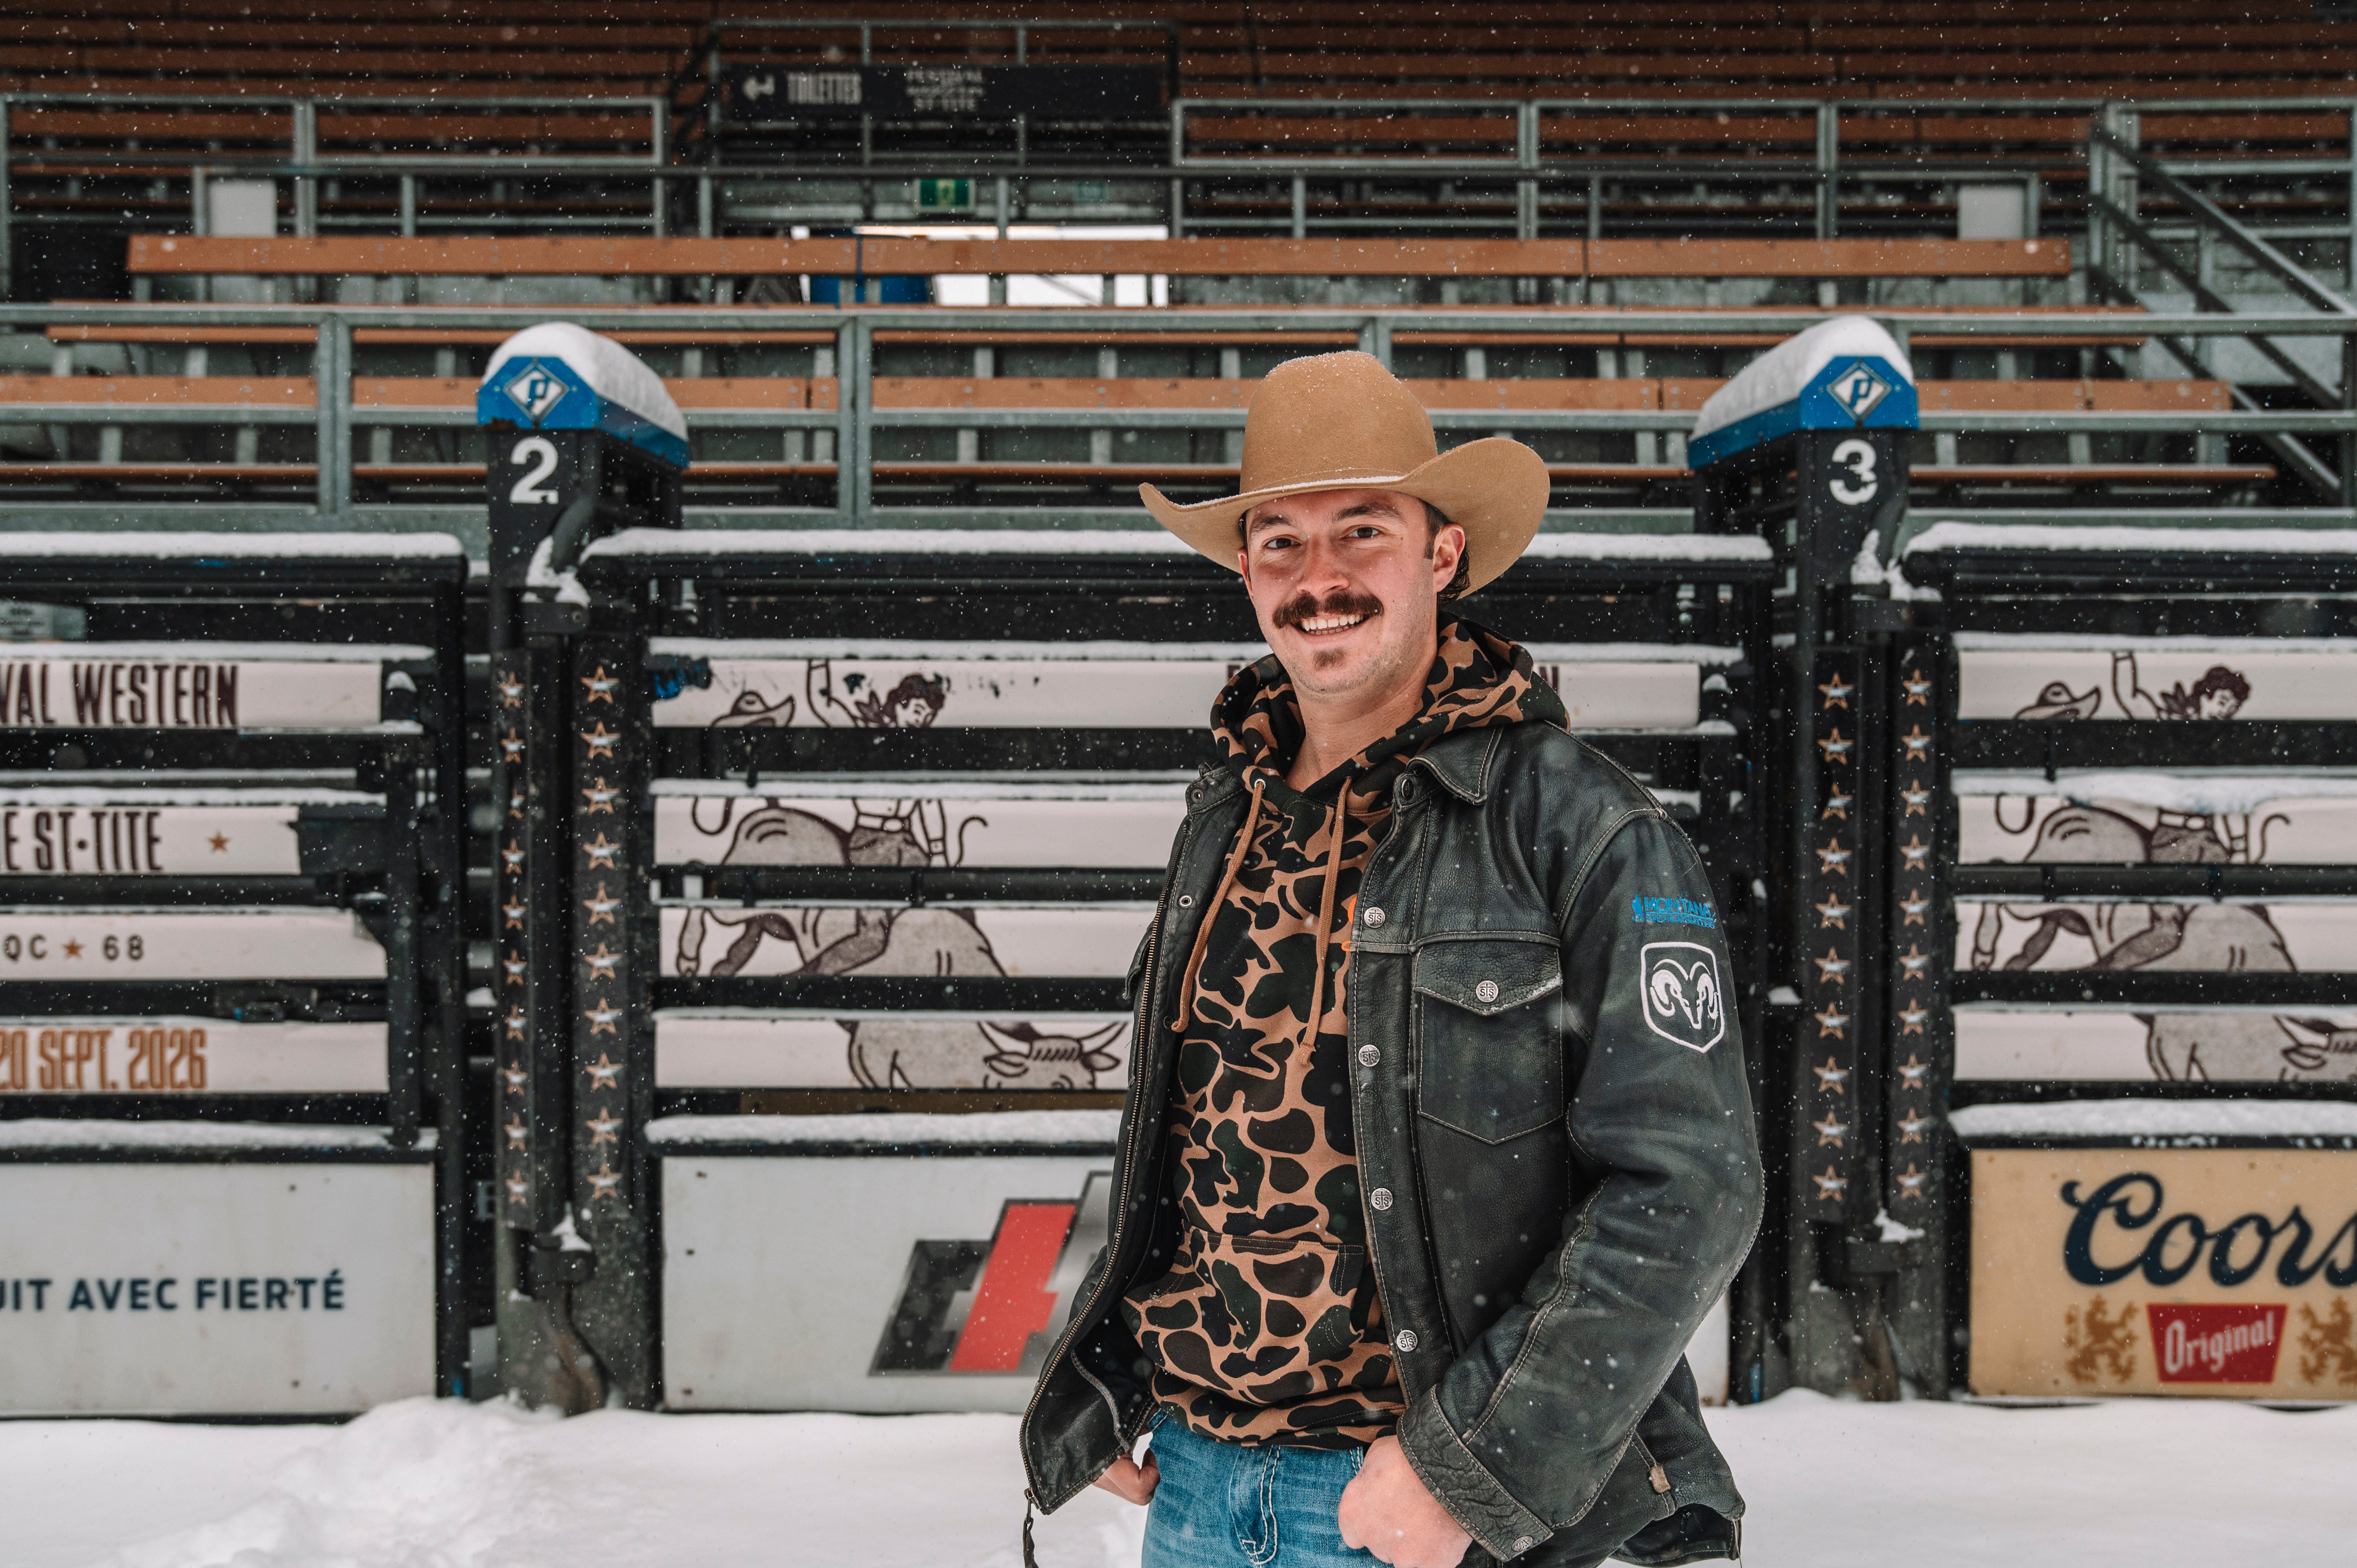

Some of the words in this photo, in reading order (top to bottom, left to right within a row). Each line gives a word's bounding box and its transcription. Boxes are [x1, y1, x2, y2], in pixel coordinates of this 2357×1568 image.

[509, 436, 559, 504] 2
[1828, 439, 1878, 506] 3
[72, 664, 240, 726] WESTERN
[1643, 896, 1713, 918] MONTANA
[103, 935, 145, 961] 68
[39, 1030, 118, 1090] SEPT.
[128, 1028, 207, 1091] 2026
[2061, 1171, 2357, 1287] Coors
[0, 1278, 52, 1311] IT
[68, 1278, 178, 1311] AVEC
[195, 1268, 345, 1311] FIERTÉ
[2165, 1310, 2275, 1375] Original
